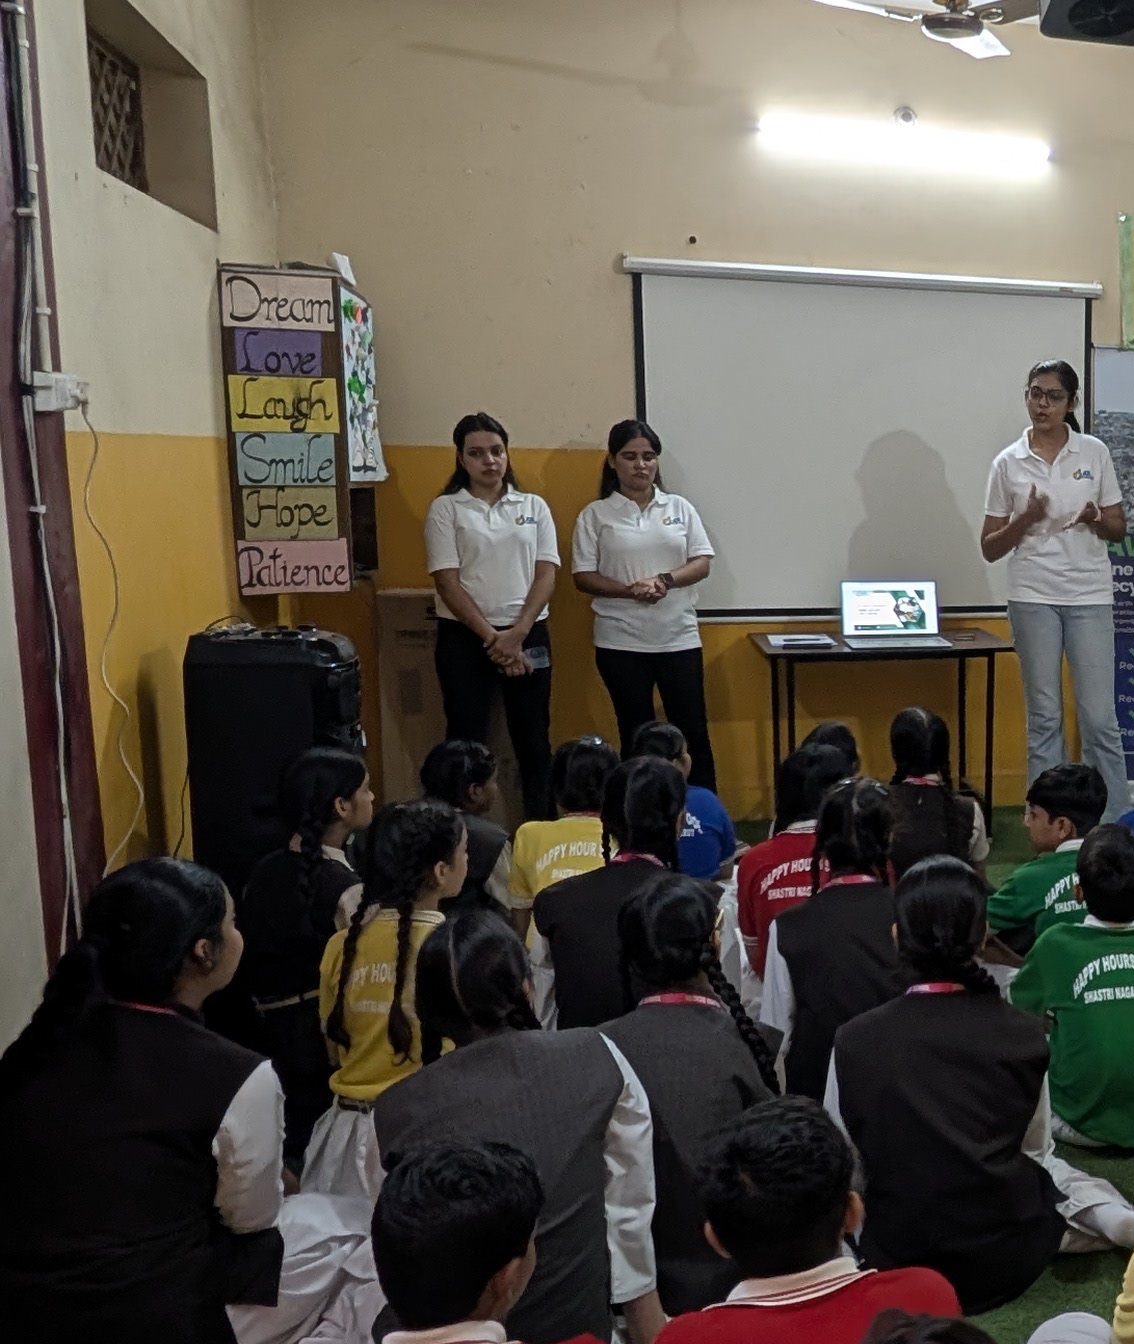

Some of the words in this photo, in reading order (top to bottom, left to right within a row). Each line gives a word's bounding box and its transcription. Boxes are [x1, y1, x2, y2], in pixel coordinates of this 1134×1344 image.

[225, 275, 335, 325] Dream
[241, 330, 318, 375] Love
[235, 377, 334, 433] Laugh
[240, 432, 335, 485] Smile
[246, 486, 336, 540] Hope
[238, 546, 349, 589] Patience
[1112, 564, 1134, 577] ne
[1073, 958, 1101, 999] HAPPY
